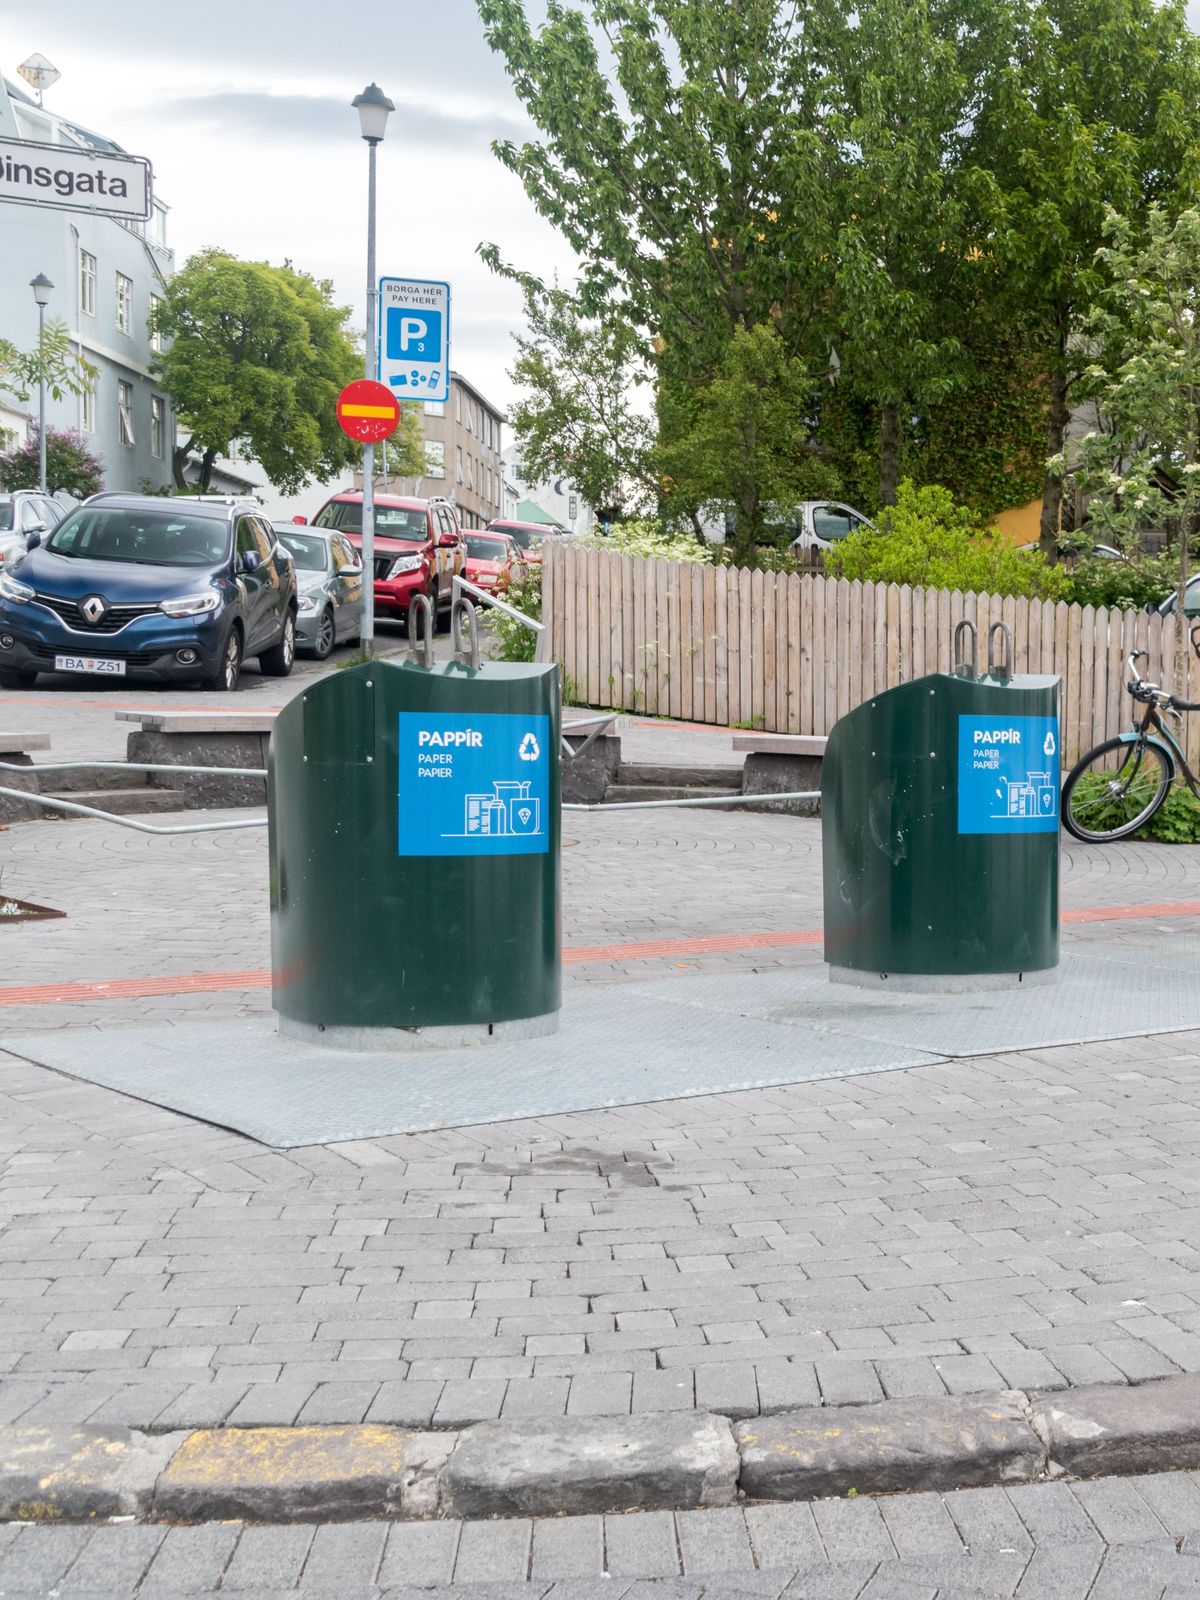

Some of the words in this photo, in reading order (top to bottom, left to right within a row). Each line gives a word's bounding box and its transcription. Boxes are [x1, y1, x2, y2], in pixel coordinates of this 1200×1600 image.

[0, 154, 128, 198] insgata
[387, 284, 421, 295] BORGA
[423, 287, 442, 296] HÉR
[392, 294, 410, 303] PAY
[412, 297, 438, 305] HERE
[400, 317, 428, 352] P
[417, 342, 425, 352] 3
[65, 658, 84, 669] BA
[97, 660, 120, 672] Z51
[418, 728, 483, 748] PAPPÍR
[973, 728, 1021, 744] PAPPÍR
[418, 753, 453, 764] PAPER
[973, 748, 1000, 758] PAPER
[973, 760, 1000, 769] PAPIER
[418, 767, 453, 778] PAPIER
